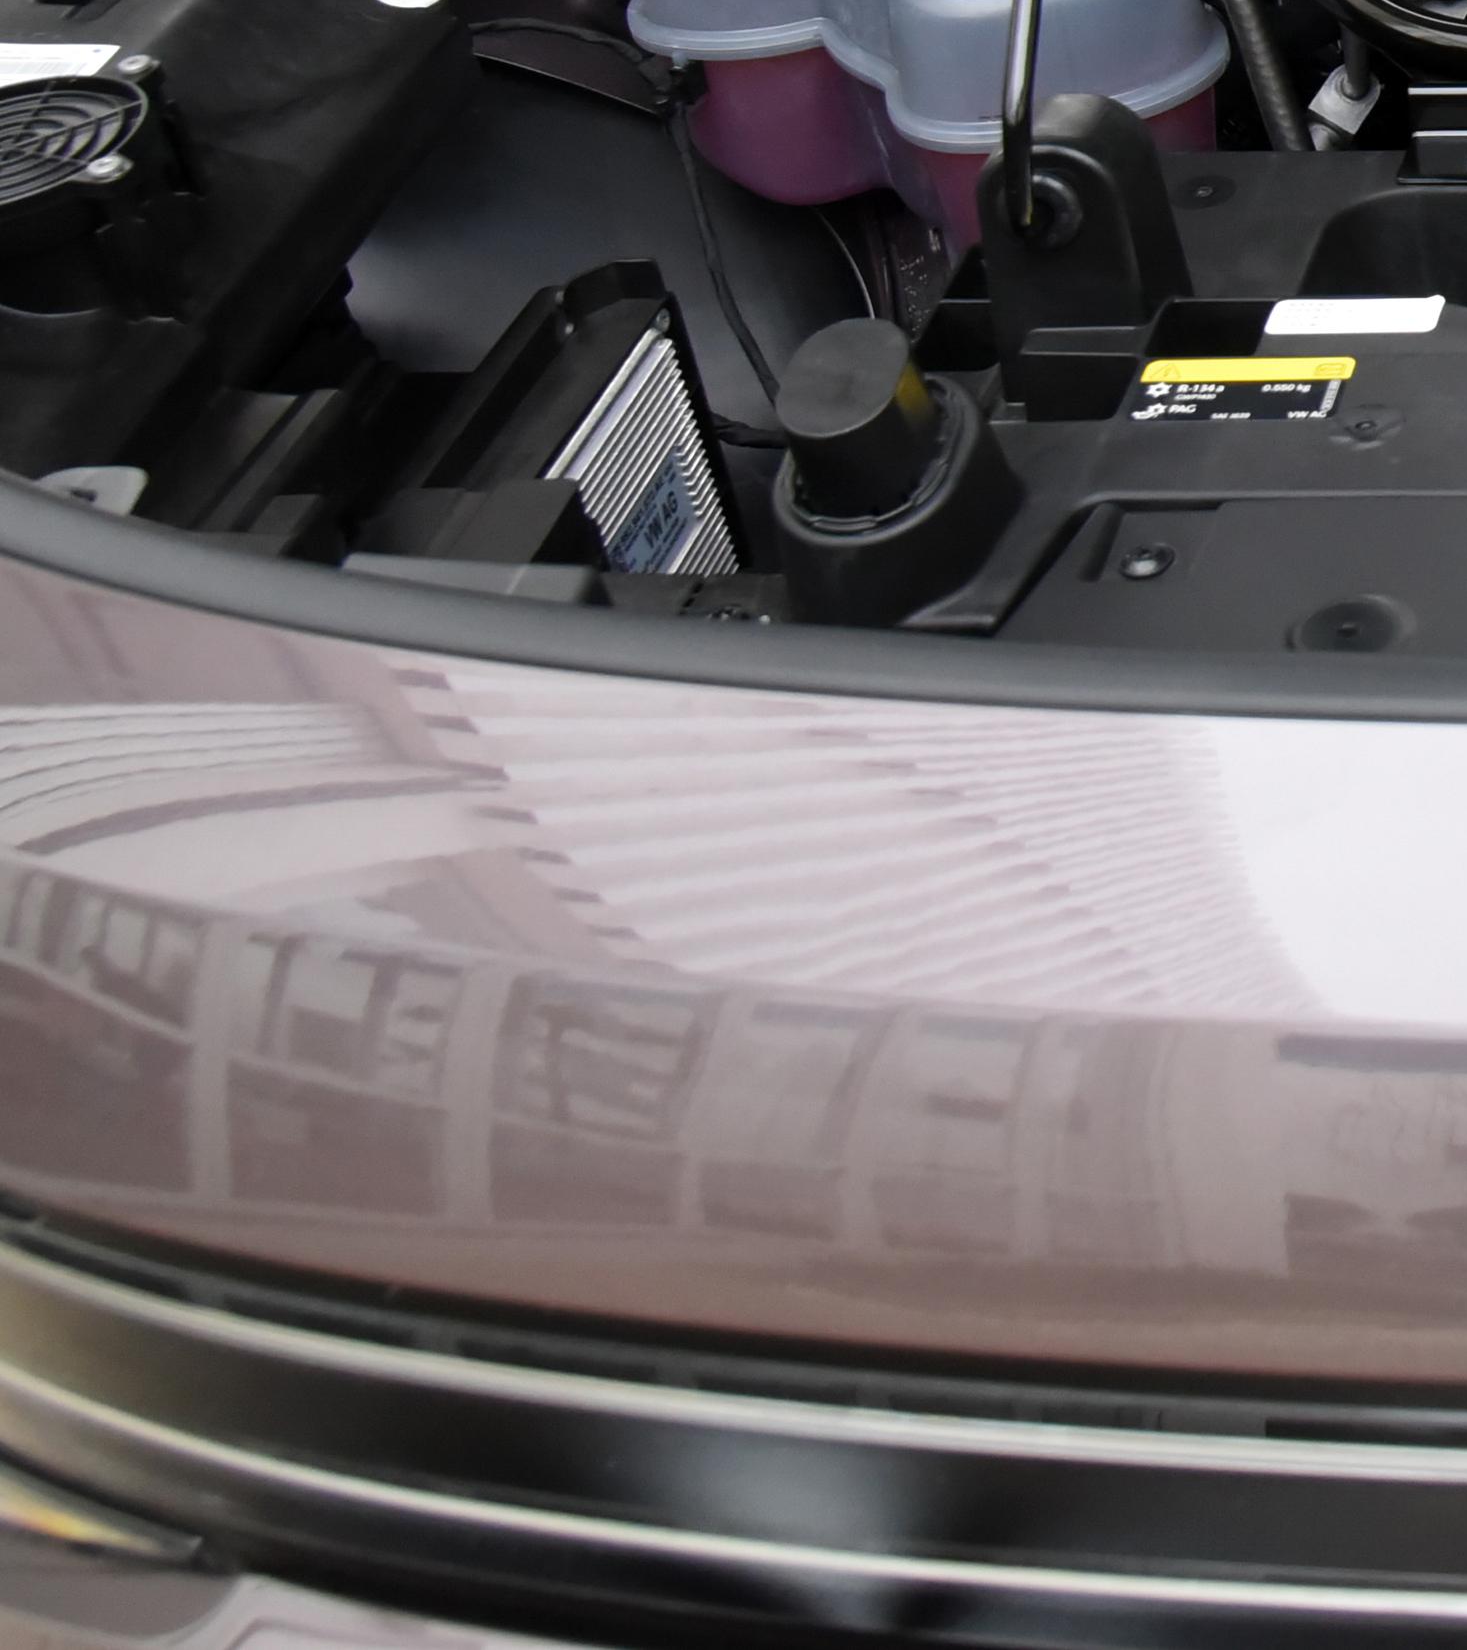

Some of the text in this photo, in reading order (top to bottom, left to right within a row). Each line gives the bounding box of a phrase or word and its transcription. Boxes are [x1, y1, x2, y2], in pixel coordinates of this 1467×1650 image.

[1168, 403, 1197, 414] PAG
[1286, 411, 1308, 419] VW
[661, 490, 679, 522] AG
